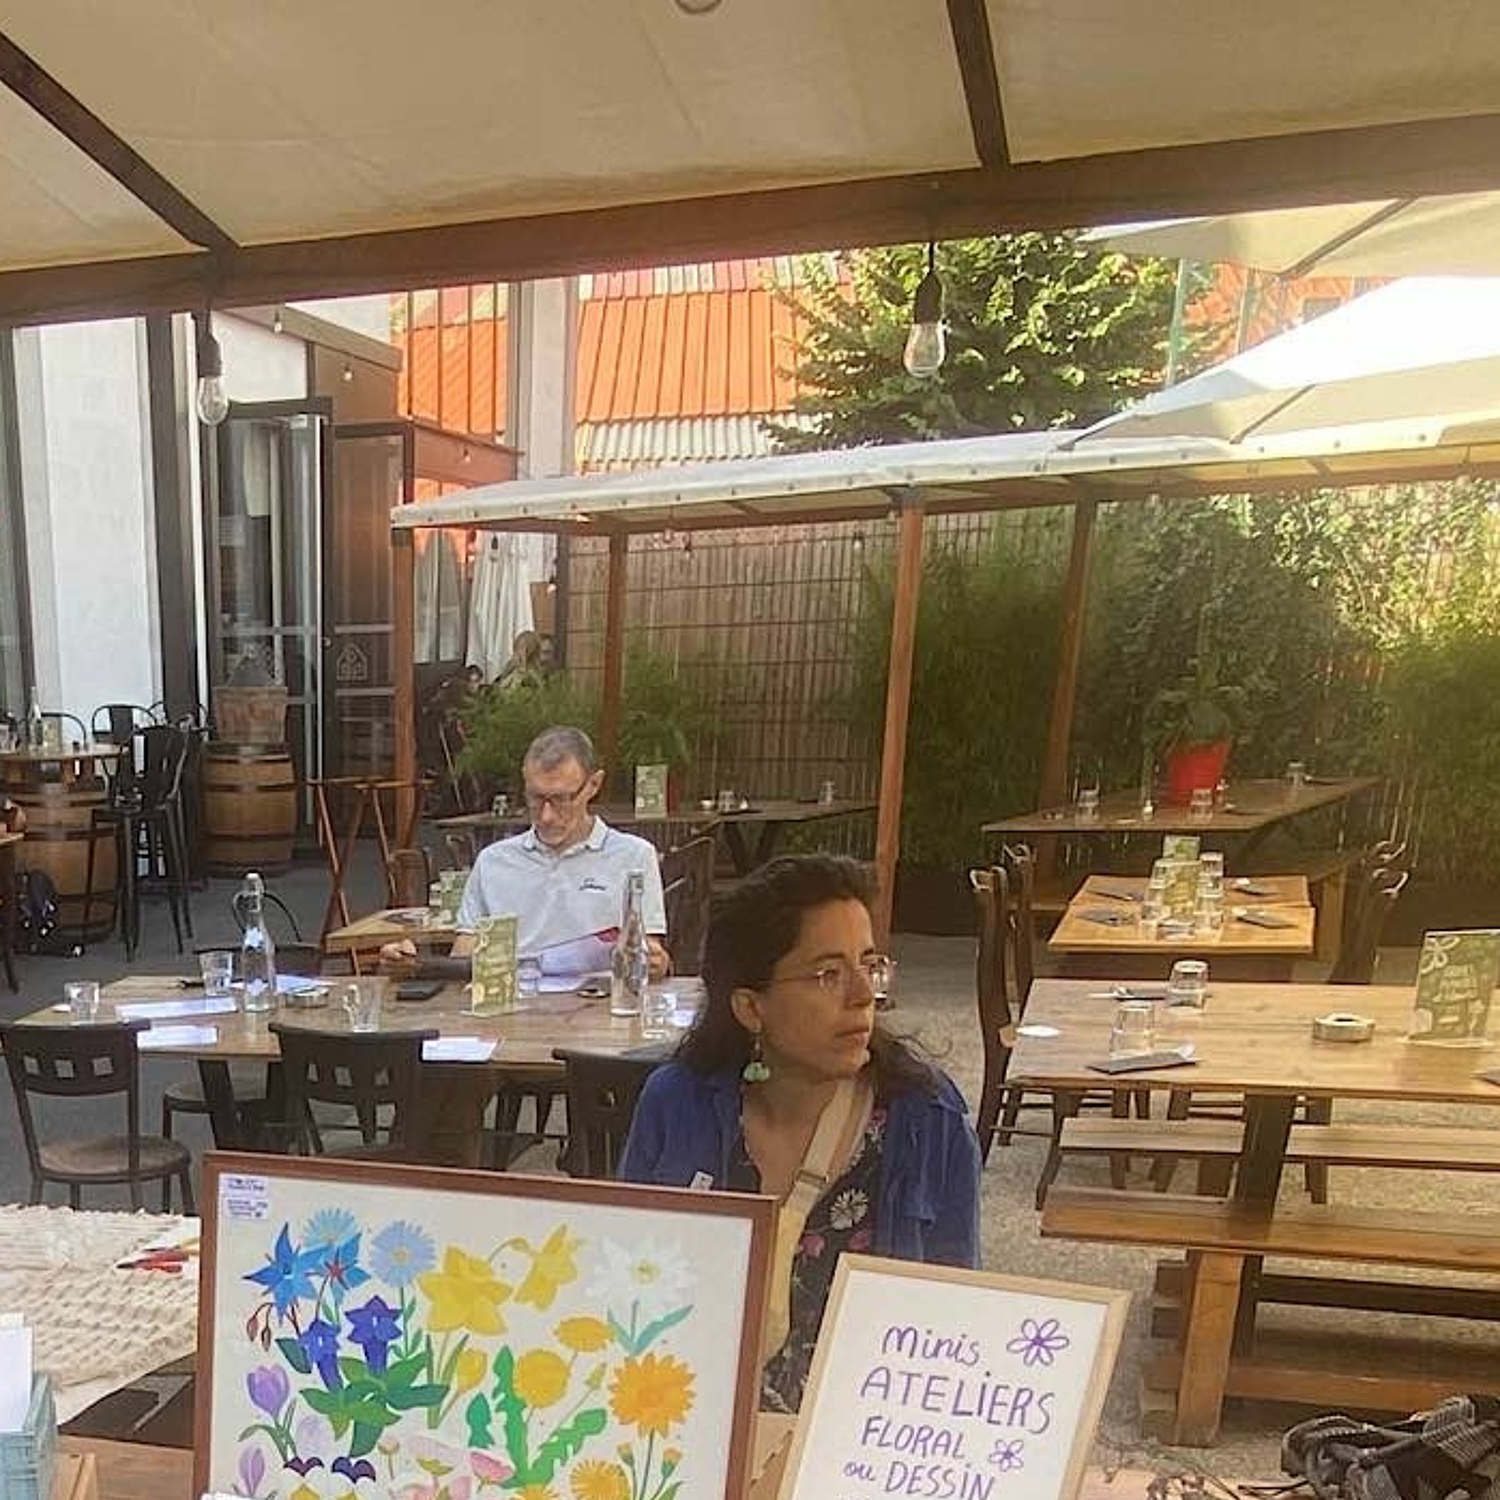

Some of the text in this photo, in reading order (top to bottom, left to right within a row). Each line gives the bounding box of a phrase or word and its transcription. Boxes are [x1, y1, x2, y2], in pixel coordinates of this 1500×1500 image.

[882, 1326, 980, 1366] Minis
[860, 1366, 1055, 1435] ATELIERS
[861, 1415, 966, 1458] FLORAL
[844, 1461, 876, 1482] ou
